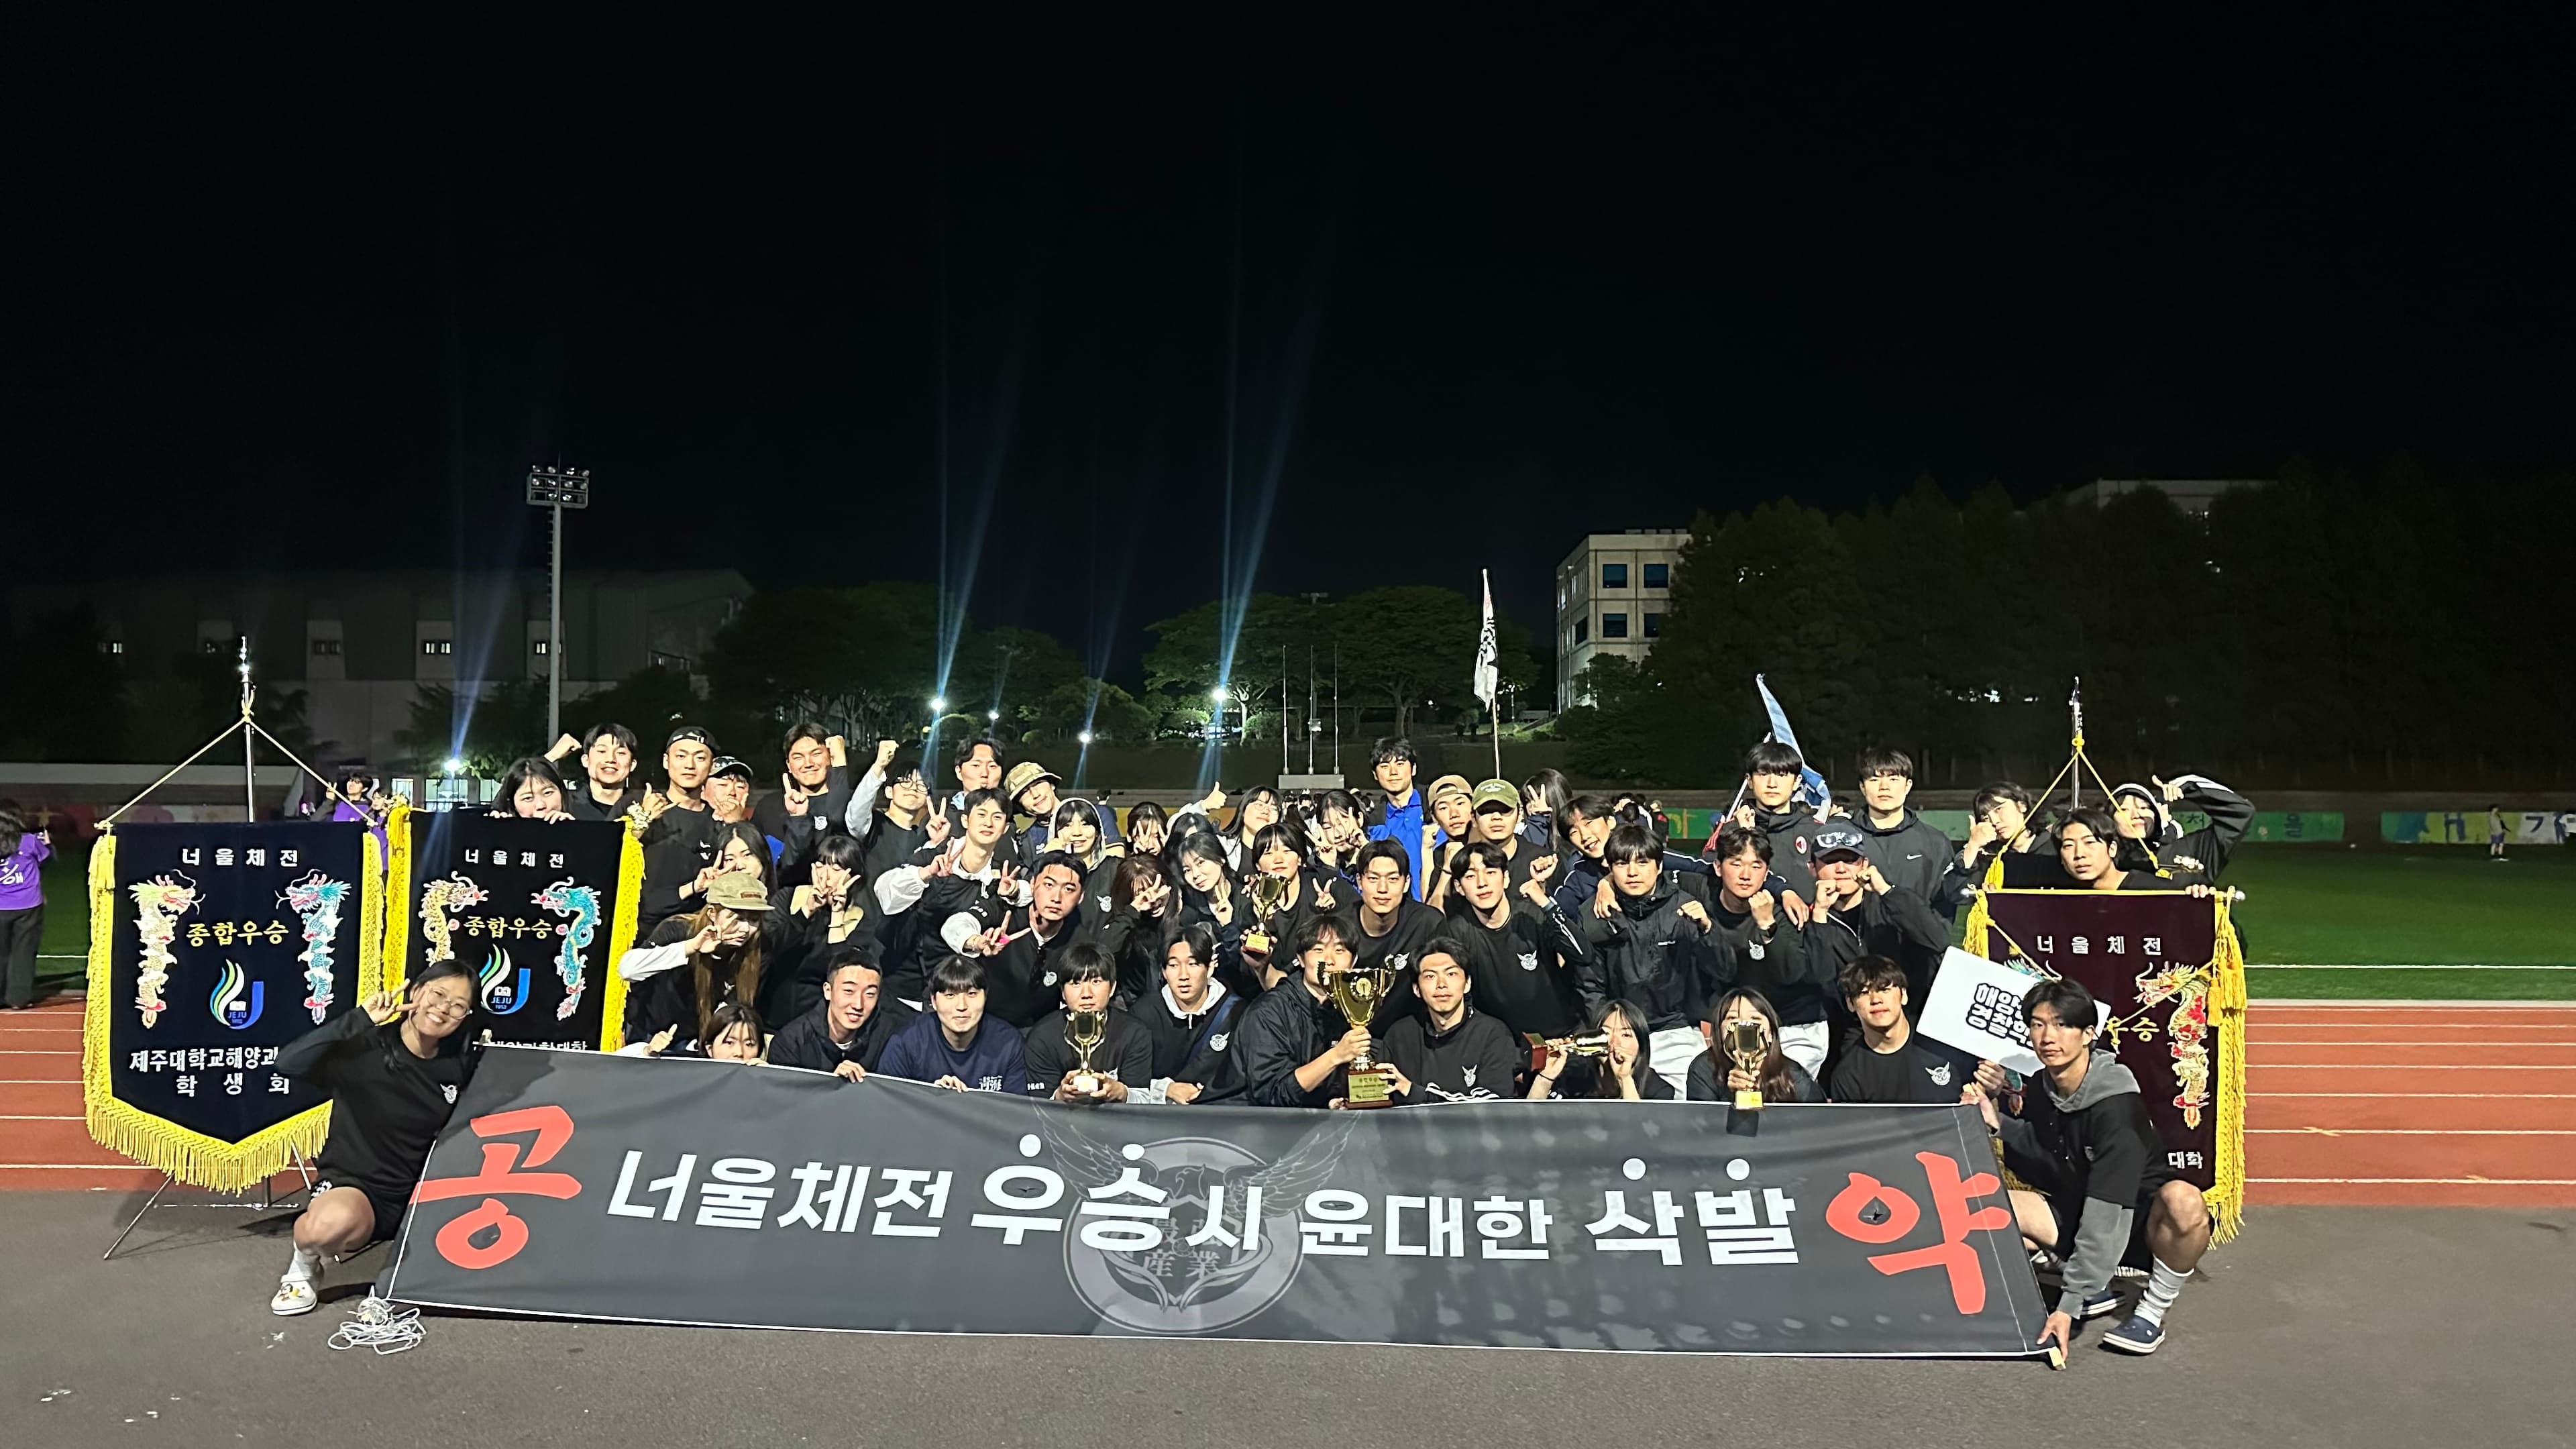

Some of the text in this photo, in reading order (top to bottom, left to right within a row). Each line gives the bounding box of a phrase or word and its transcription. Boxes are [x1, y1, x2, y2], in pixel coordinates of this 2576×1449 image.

[182, 848, 299, 867] 너울체전
[465, 849, 564, 869] 너울체전
[186, 920, 289, 947] 종합우승
[463, 916, 553, 939] 종합우승
[2037, 935, 2161, 956] 너울체전
[491, 996, 512, 1004] JEJU
[1974, 983, 2023, 1020] 해양
[1966, 1003, 2034, 1051] 경찰학
[2104, 1016, 2159, 1042] 우승
[129, 1046, 279, 1073] 제주대학교해양과
[409, 1105, 583, 1269] 공
[607, 1150, 954, 1238] 너울체전
[1299, 1189, 1554, 1260] 윤대한
[1585, 1187, 1799, 1267] 삭발
[1825, 1151, 2012, 1315] 약
